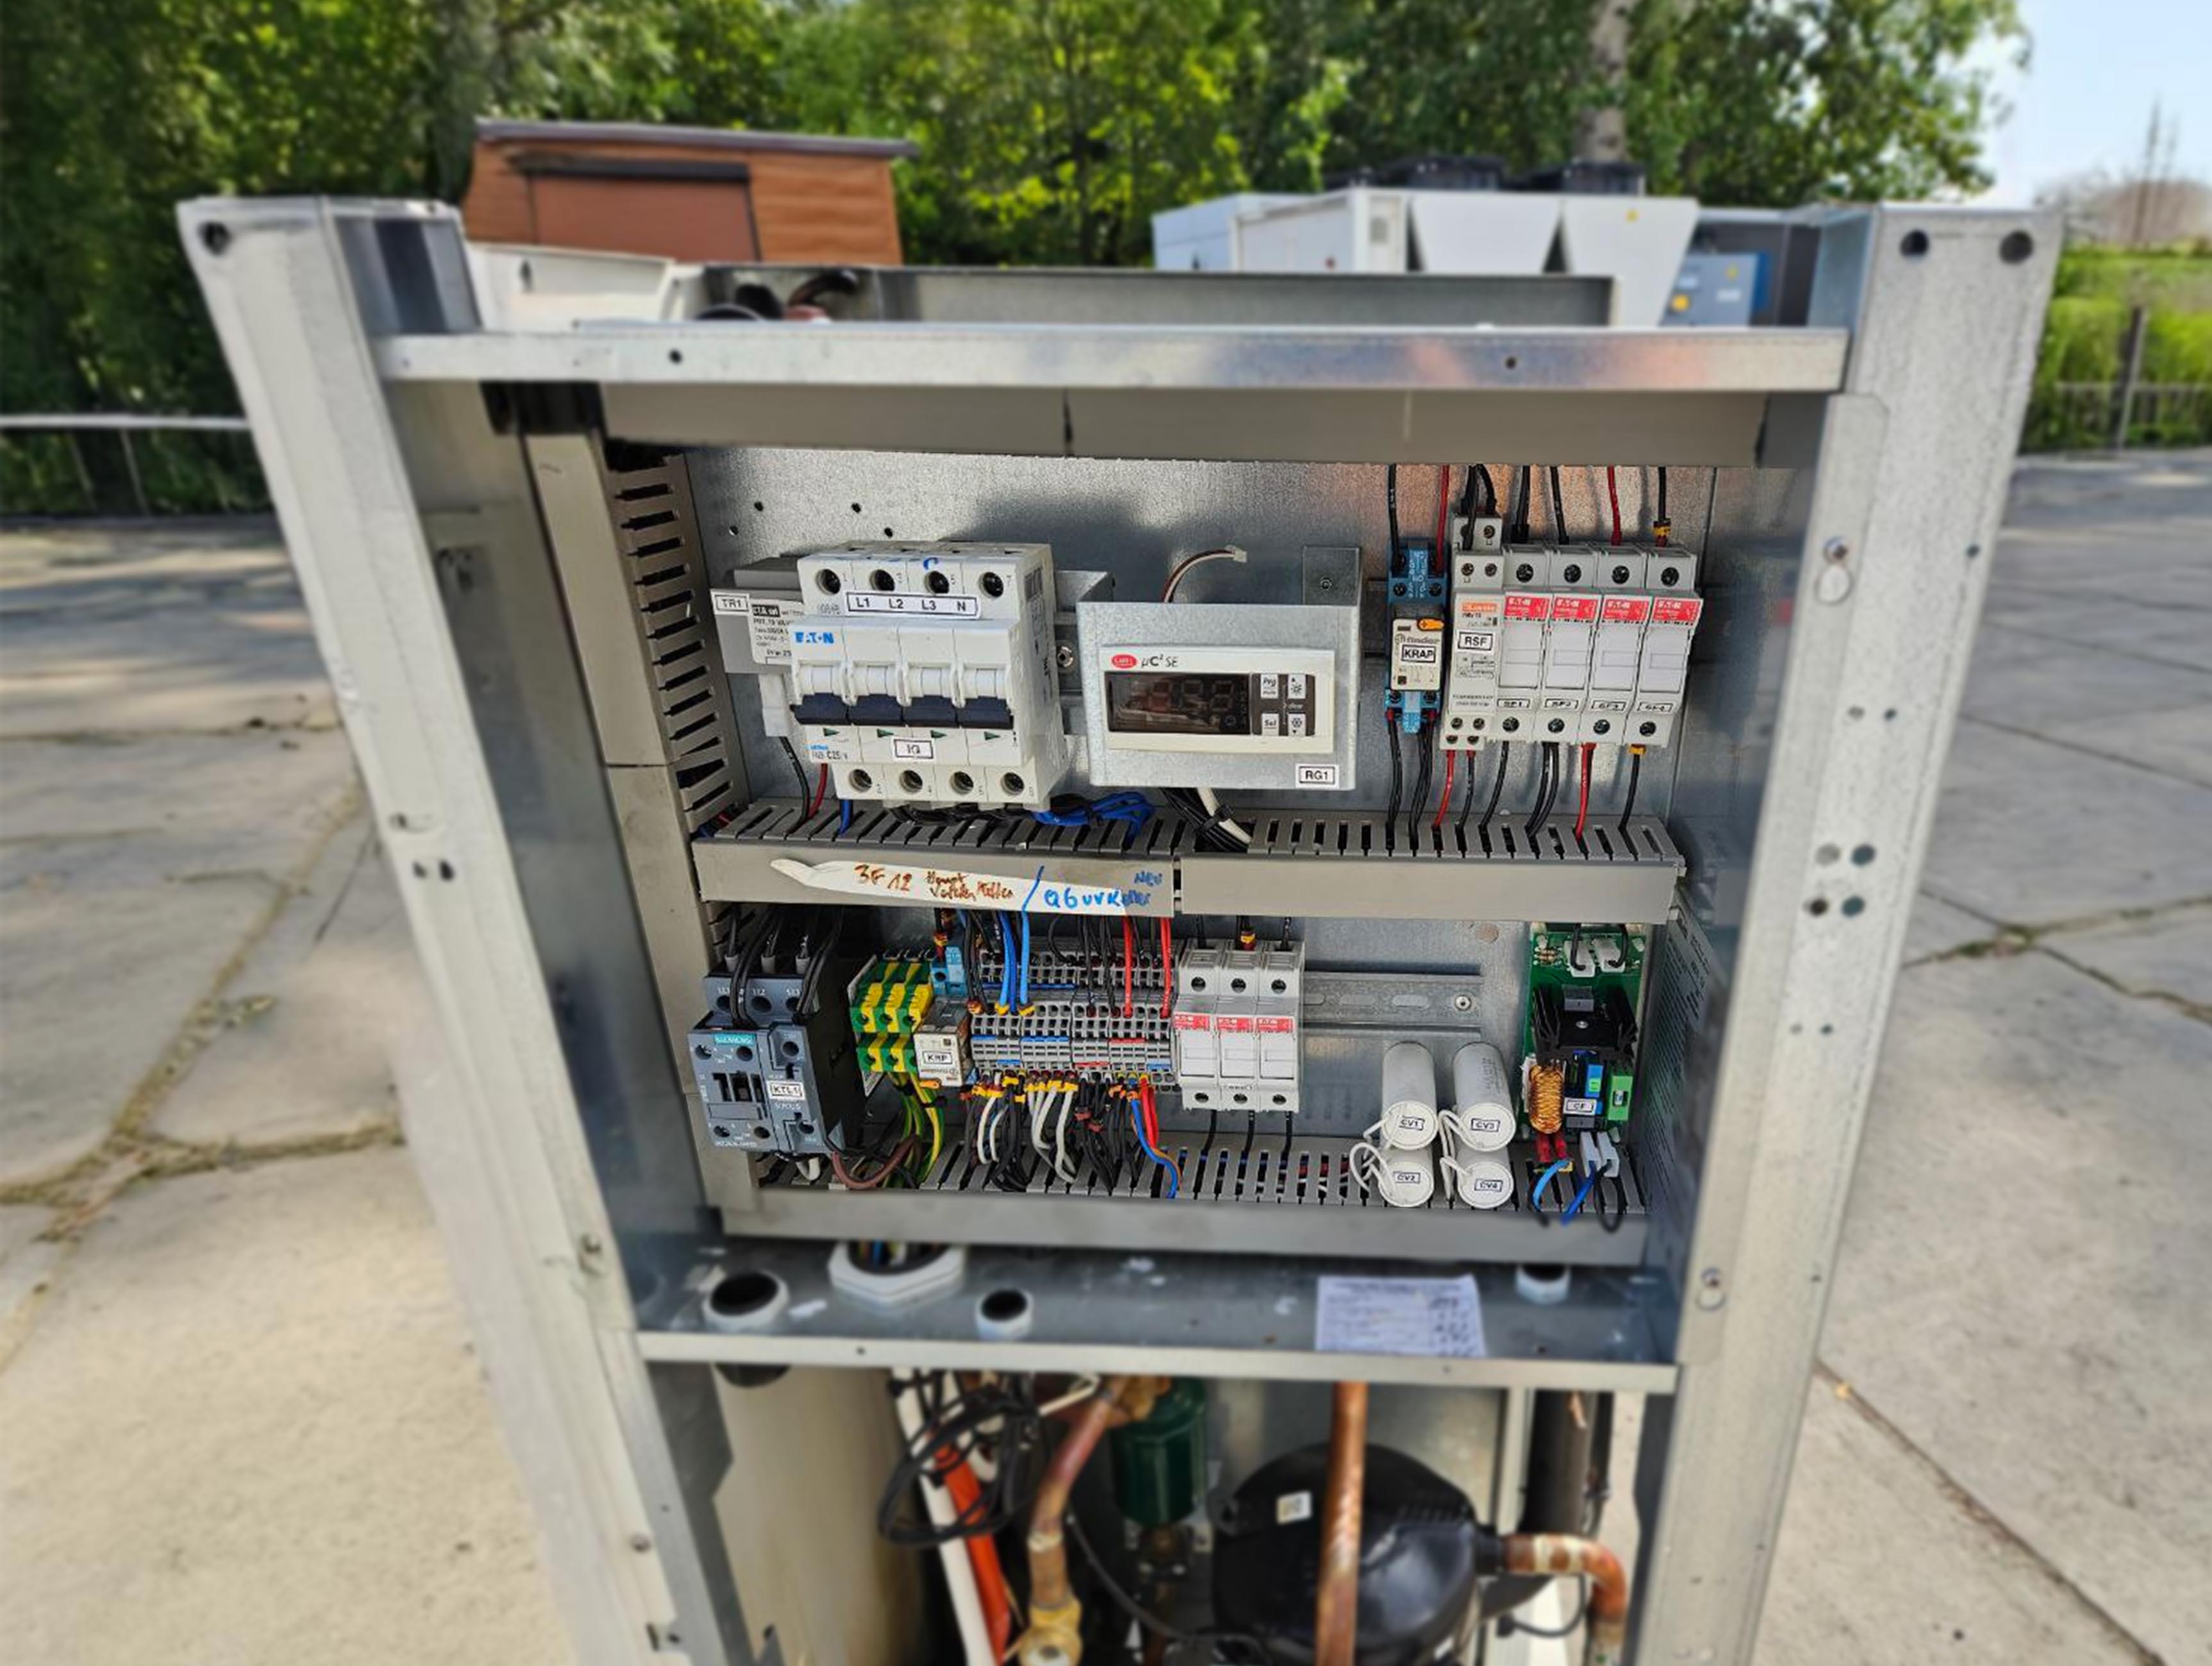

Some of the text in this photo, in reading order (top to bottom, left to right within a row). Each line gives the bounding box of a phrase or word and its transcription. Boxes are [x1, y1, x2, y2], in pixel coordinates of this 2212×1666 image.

[722, 598, 741, 608] TR1
[856, 597, 966, 612] L1 L2 L3 N
[1465, 636, 1487, 646] RSF
[1404, 649, 1434, 659] KRAP
[1305, 770, 1328, 780] RG1
